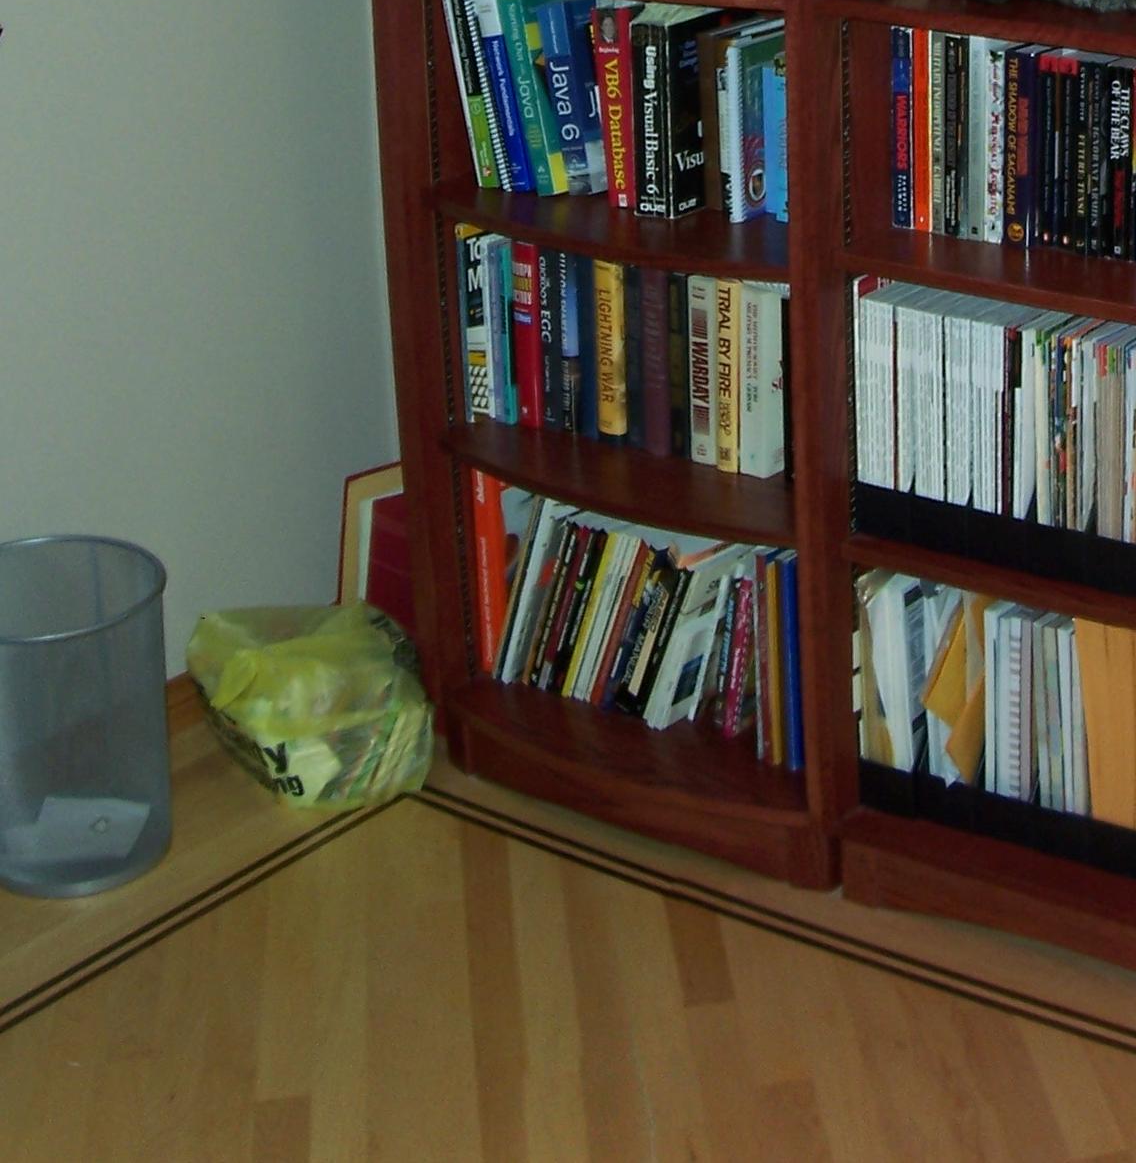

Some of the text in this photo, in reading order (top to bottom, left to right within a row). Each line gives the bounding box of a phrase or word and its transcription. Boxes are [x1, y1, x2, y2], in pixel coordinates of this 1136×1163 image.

[517, 75, 535, 119] Java
[548, 61, 580, 141] Java 6
[604, 58, 626, 190] VB6 Database
[643, 45, 660, 194] Using Visual Basic 6
[1008, 82, 1018, 132] SHADOW
[1110, 80, 1121, 160] OF THE BEAR
[1120, 87, 1130, 157] THE CLAWS
[598, 289, 614, 404] LIGHTNING WAR
[691, 340, 709, 404] WARDAY
[718, 287, 731, 398] TRIAL BY FIRE
